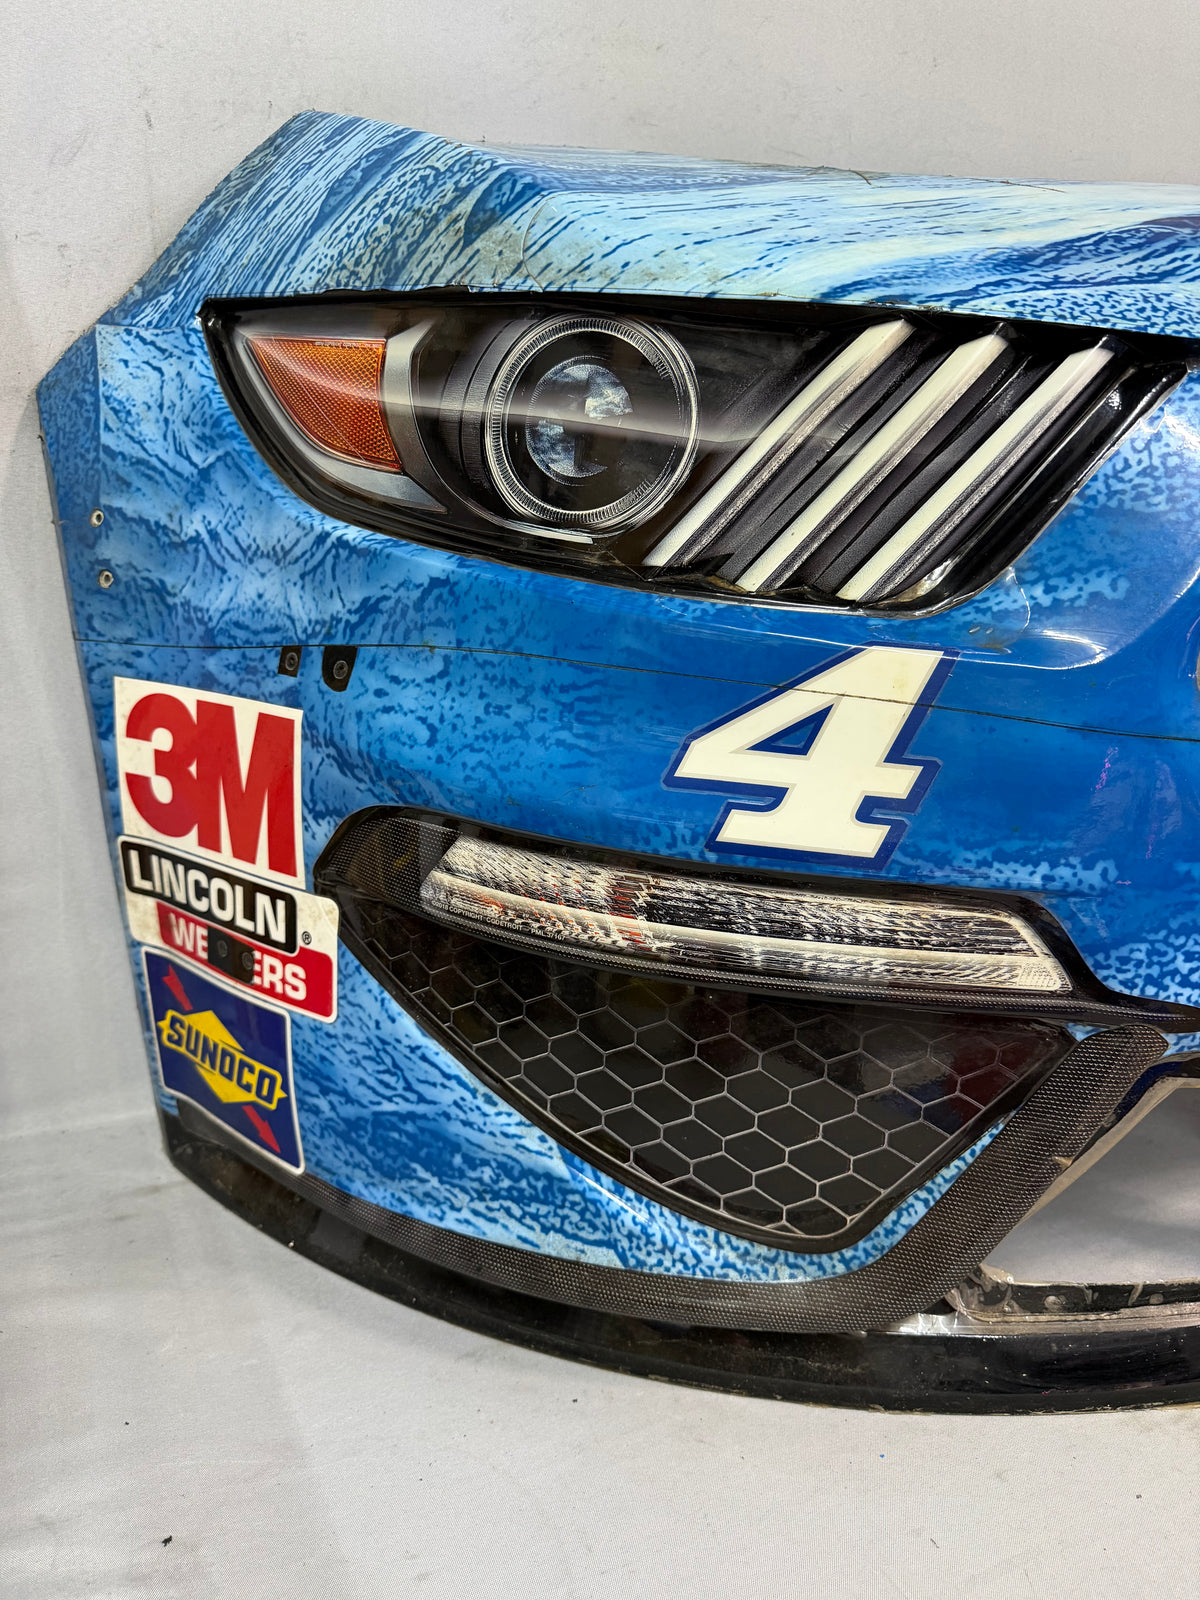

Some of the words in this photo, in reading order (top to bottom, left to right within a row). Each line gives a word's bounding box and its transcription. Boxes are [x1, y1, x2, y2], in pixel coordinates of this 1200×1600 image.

[125, 692, 298, 878] 3M
[669, 644, 949, 861] 4
[129, 849, 286, 943] LINCOLN
[168, 912, 307, 1001] WEERS
[167, 1015, 278, 1105] SUNOCO
